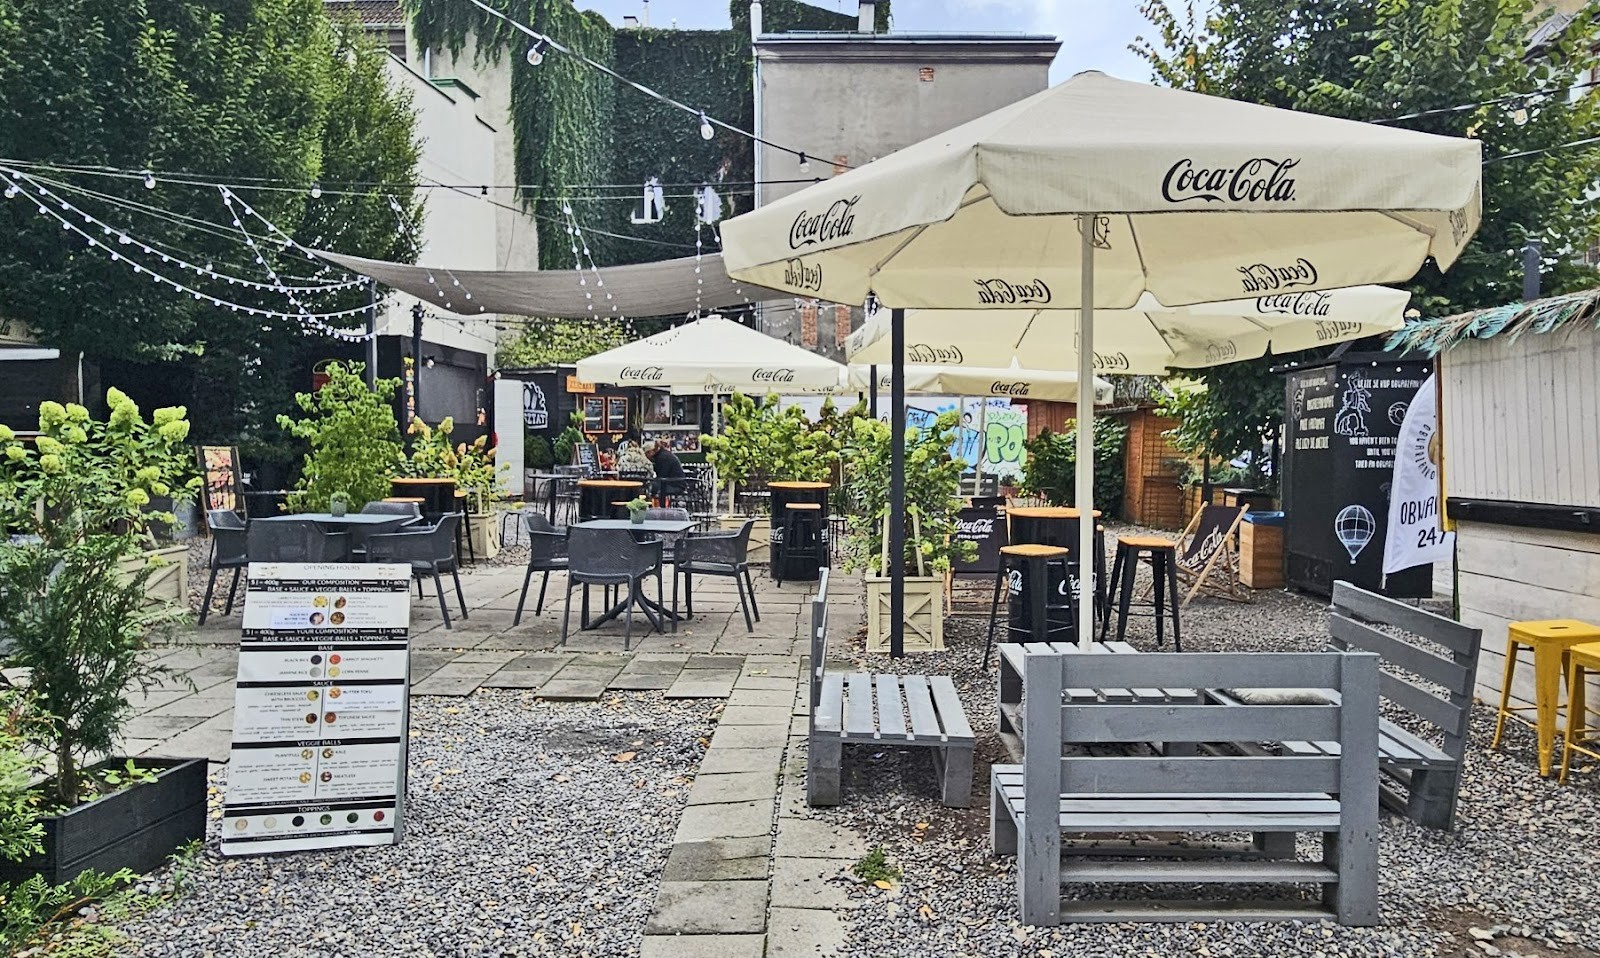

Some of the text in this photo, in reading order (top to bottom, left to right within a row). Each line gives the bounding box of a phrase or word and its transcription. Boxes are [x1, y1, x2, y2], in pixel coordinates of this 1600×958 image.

[1161, 157, 1302, 203] Coca-Cola
[789, 194, 862, 250] Coca-Cola
[620, 365, 664, 382] Coca-Cola
[752, 367, 796, 384] Coca-Cola
[990, 380, 1032, 396] Coca-Cola
